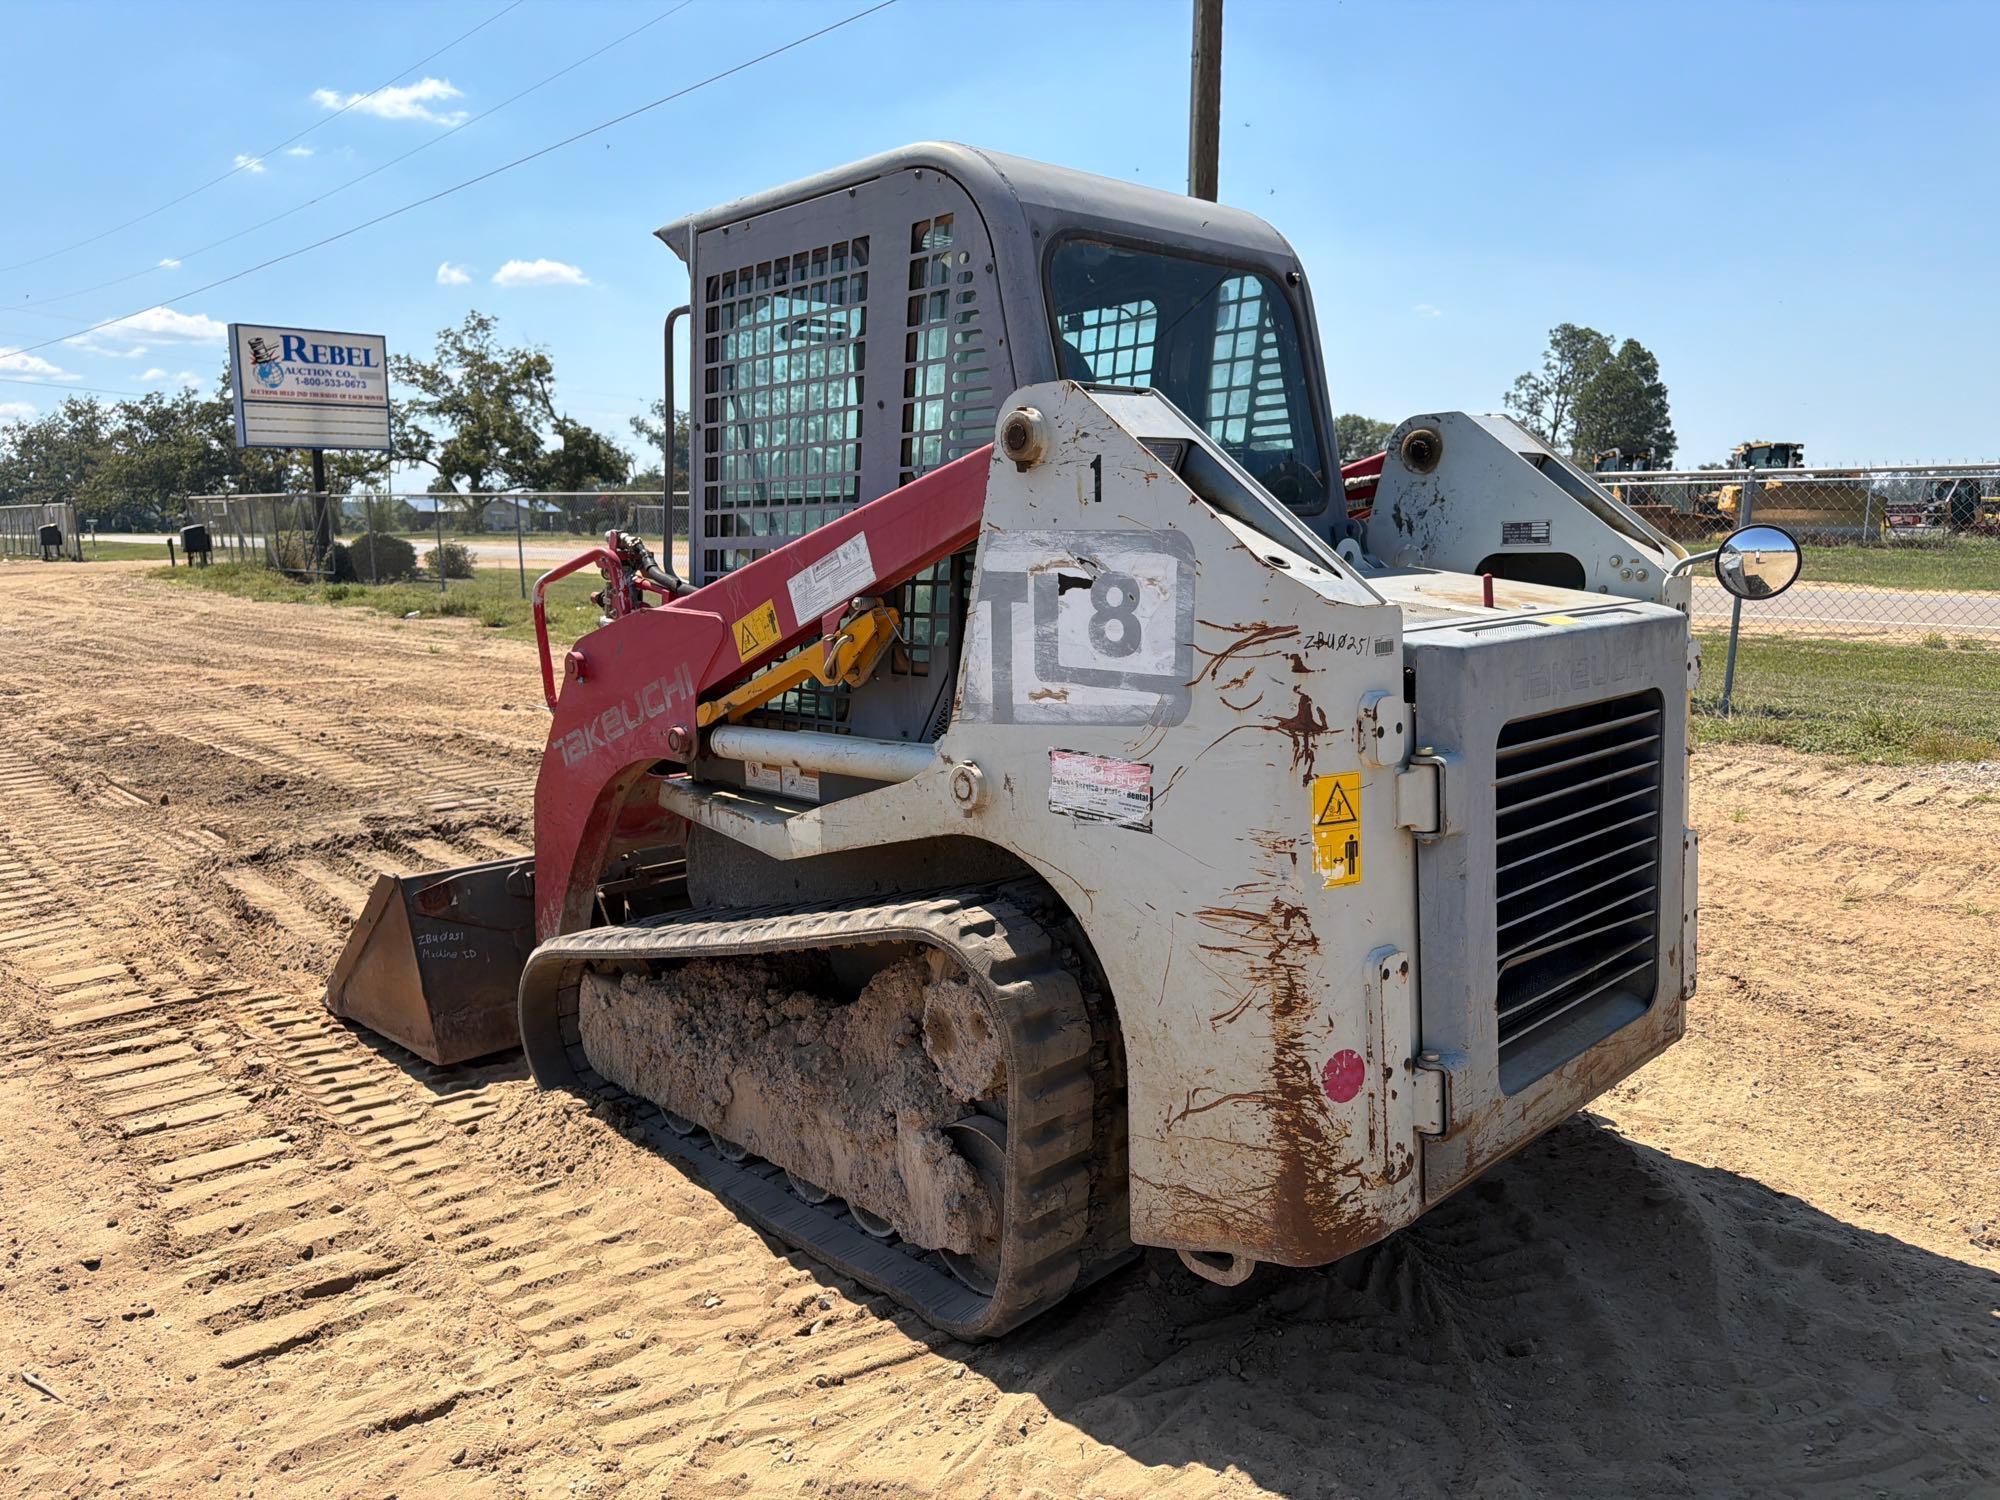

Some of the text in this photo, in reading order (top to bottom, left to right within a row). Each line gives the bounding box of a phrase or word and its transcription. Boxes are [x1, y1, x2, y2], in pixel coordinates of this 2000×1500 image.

[280, 335, 378, 368] REBEL
[284, 367, 332, 377] AUCTION
[296, 378, 367, 389] 1-800-533-0673
[1090, 454, 1102, 503] 1
